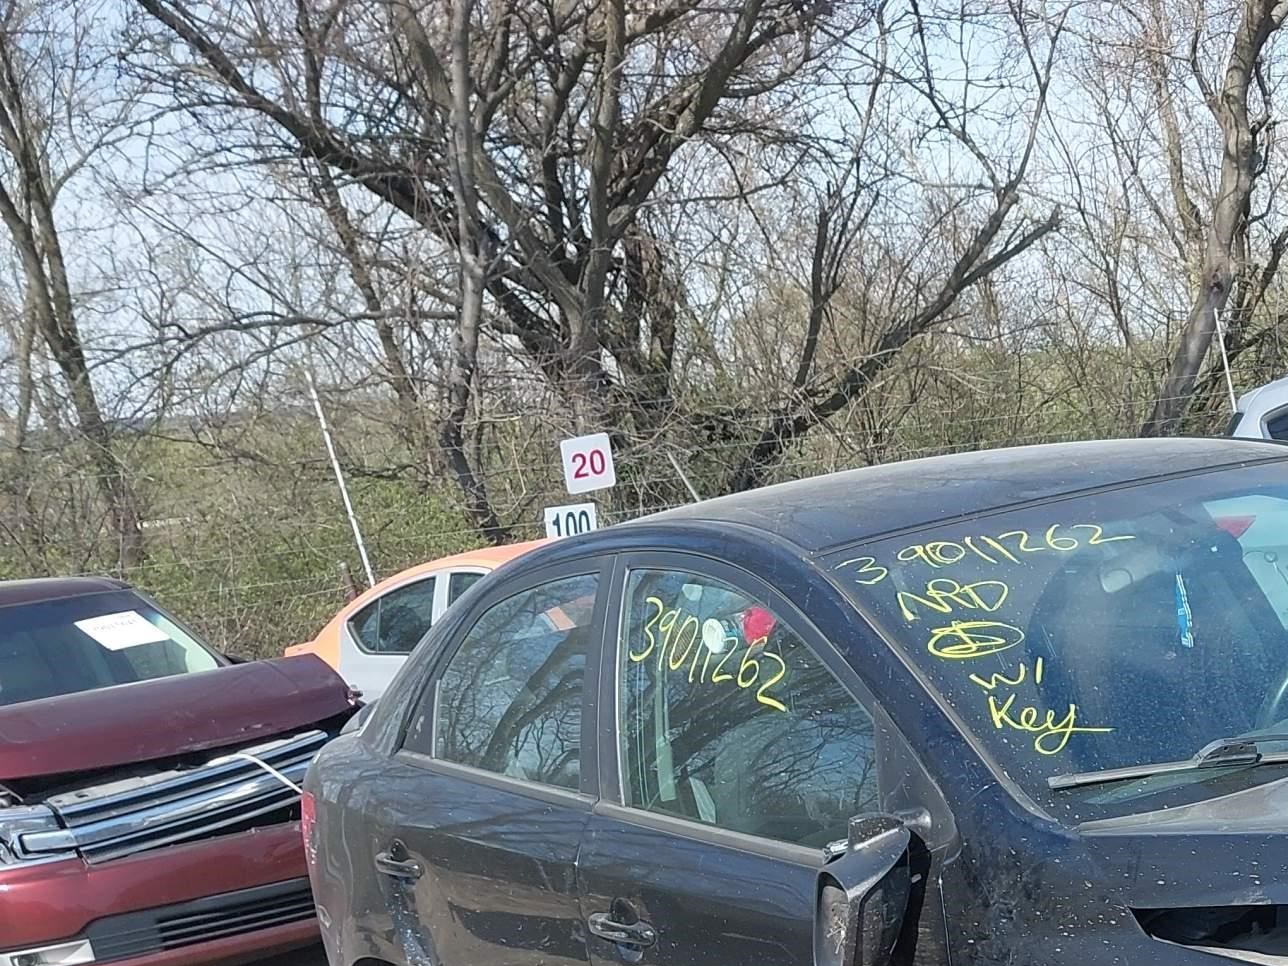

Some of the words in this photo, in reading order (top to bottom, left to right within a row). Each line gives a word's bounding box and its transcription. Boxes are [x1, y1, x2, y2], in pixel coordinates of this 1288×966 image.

[571, 448, 606, 479] 20
[552, 509, 591, 537] 100
[896, 578, 1009, 621] NRD
[629, 596, 790, 713] 39011262
[987, 692, 1118, 755] Key
